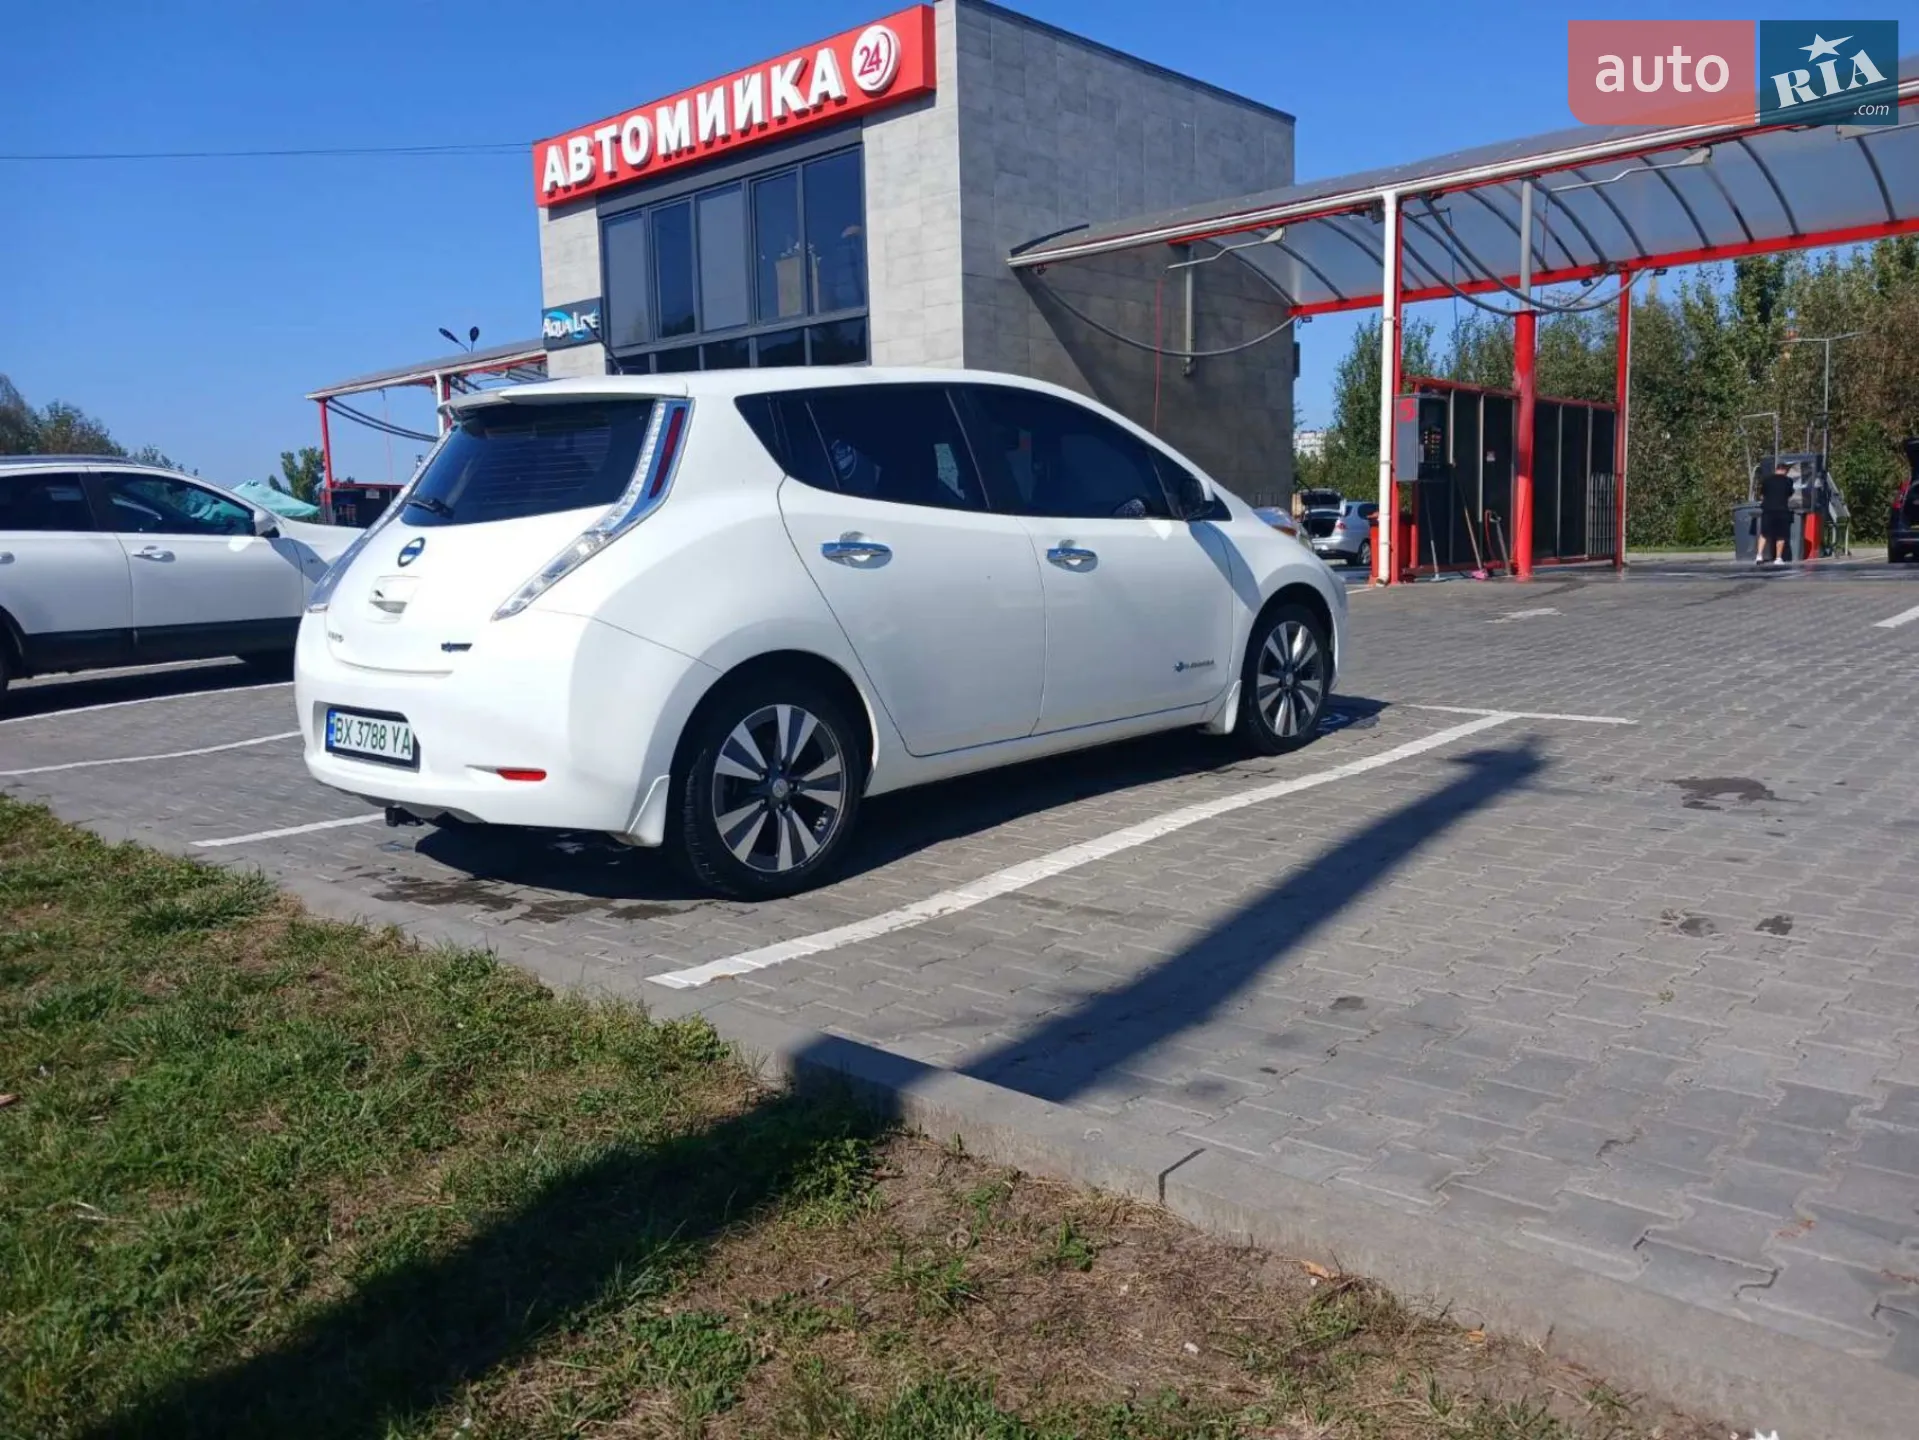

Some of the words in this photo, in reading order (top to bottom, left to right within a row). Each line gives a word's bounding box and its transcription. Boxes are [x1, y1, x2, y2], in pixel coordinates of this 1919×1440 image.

[542, 48, 845, 193] АВТОМИЙКА
[857, 38, 883, 77] 24
[334, 717, 353, 746] BX
[356, 720, 388, 751] 3788
[391, 725, 413, 757] YA
